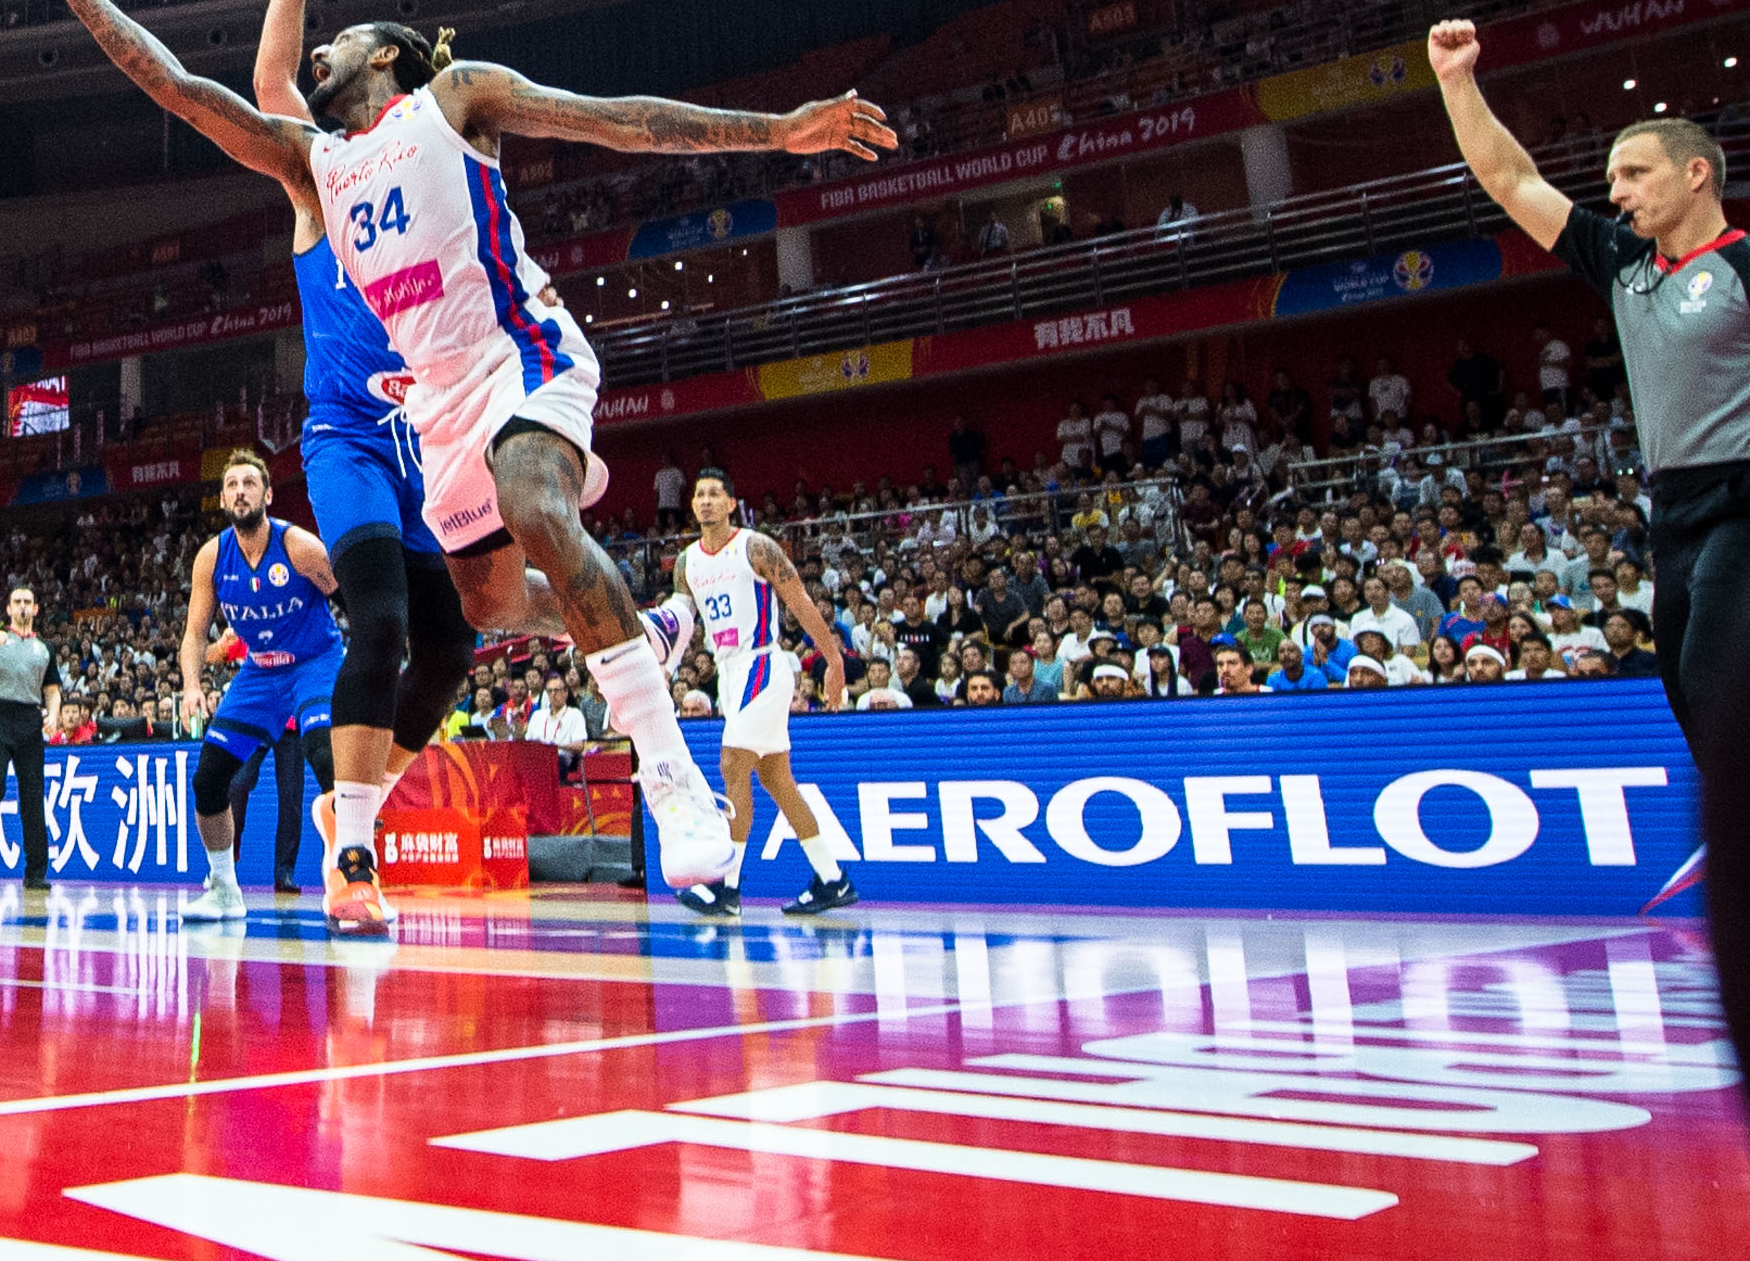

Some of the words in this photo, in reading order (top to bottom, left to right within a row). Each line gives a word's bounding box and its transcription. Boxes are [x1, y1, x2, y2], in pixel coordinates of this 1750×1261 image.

[953, 151, 1013, 181] WORLD
[1015, 144, 1049, 168] CUP
[350, 185, 411, 253] 34
[704, 593, 734, 622] 33
[760, 766, 1670, 870] AEROFLOT
